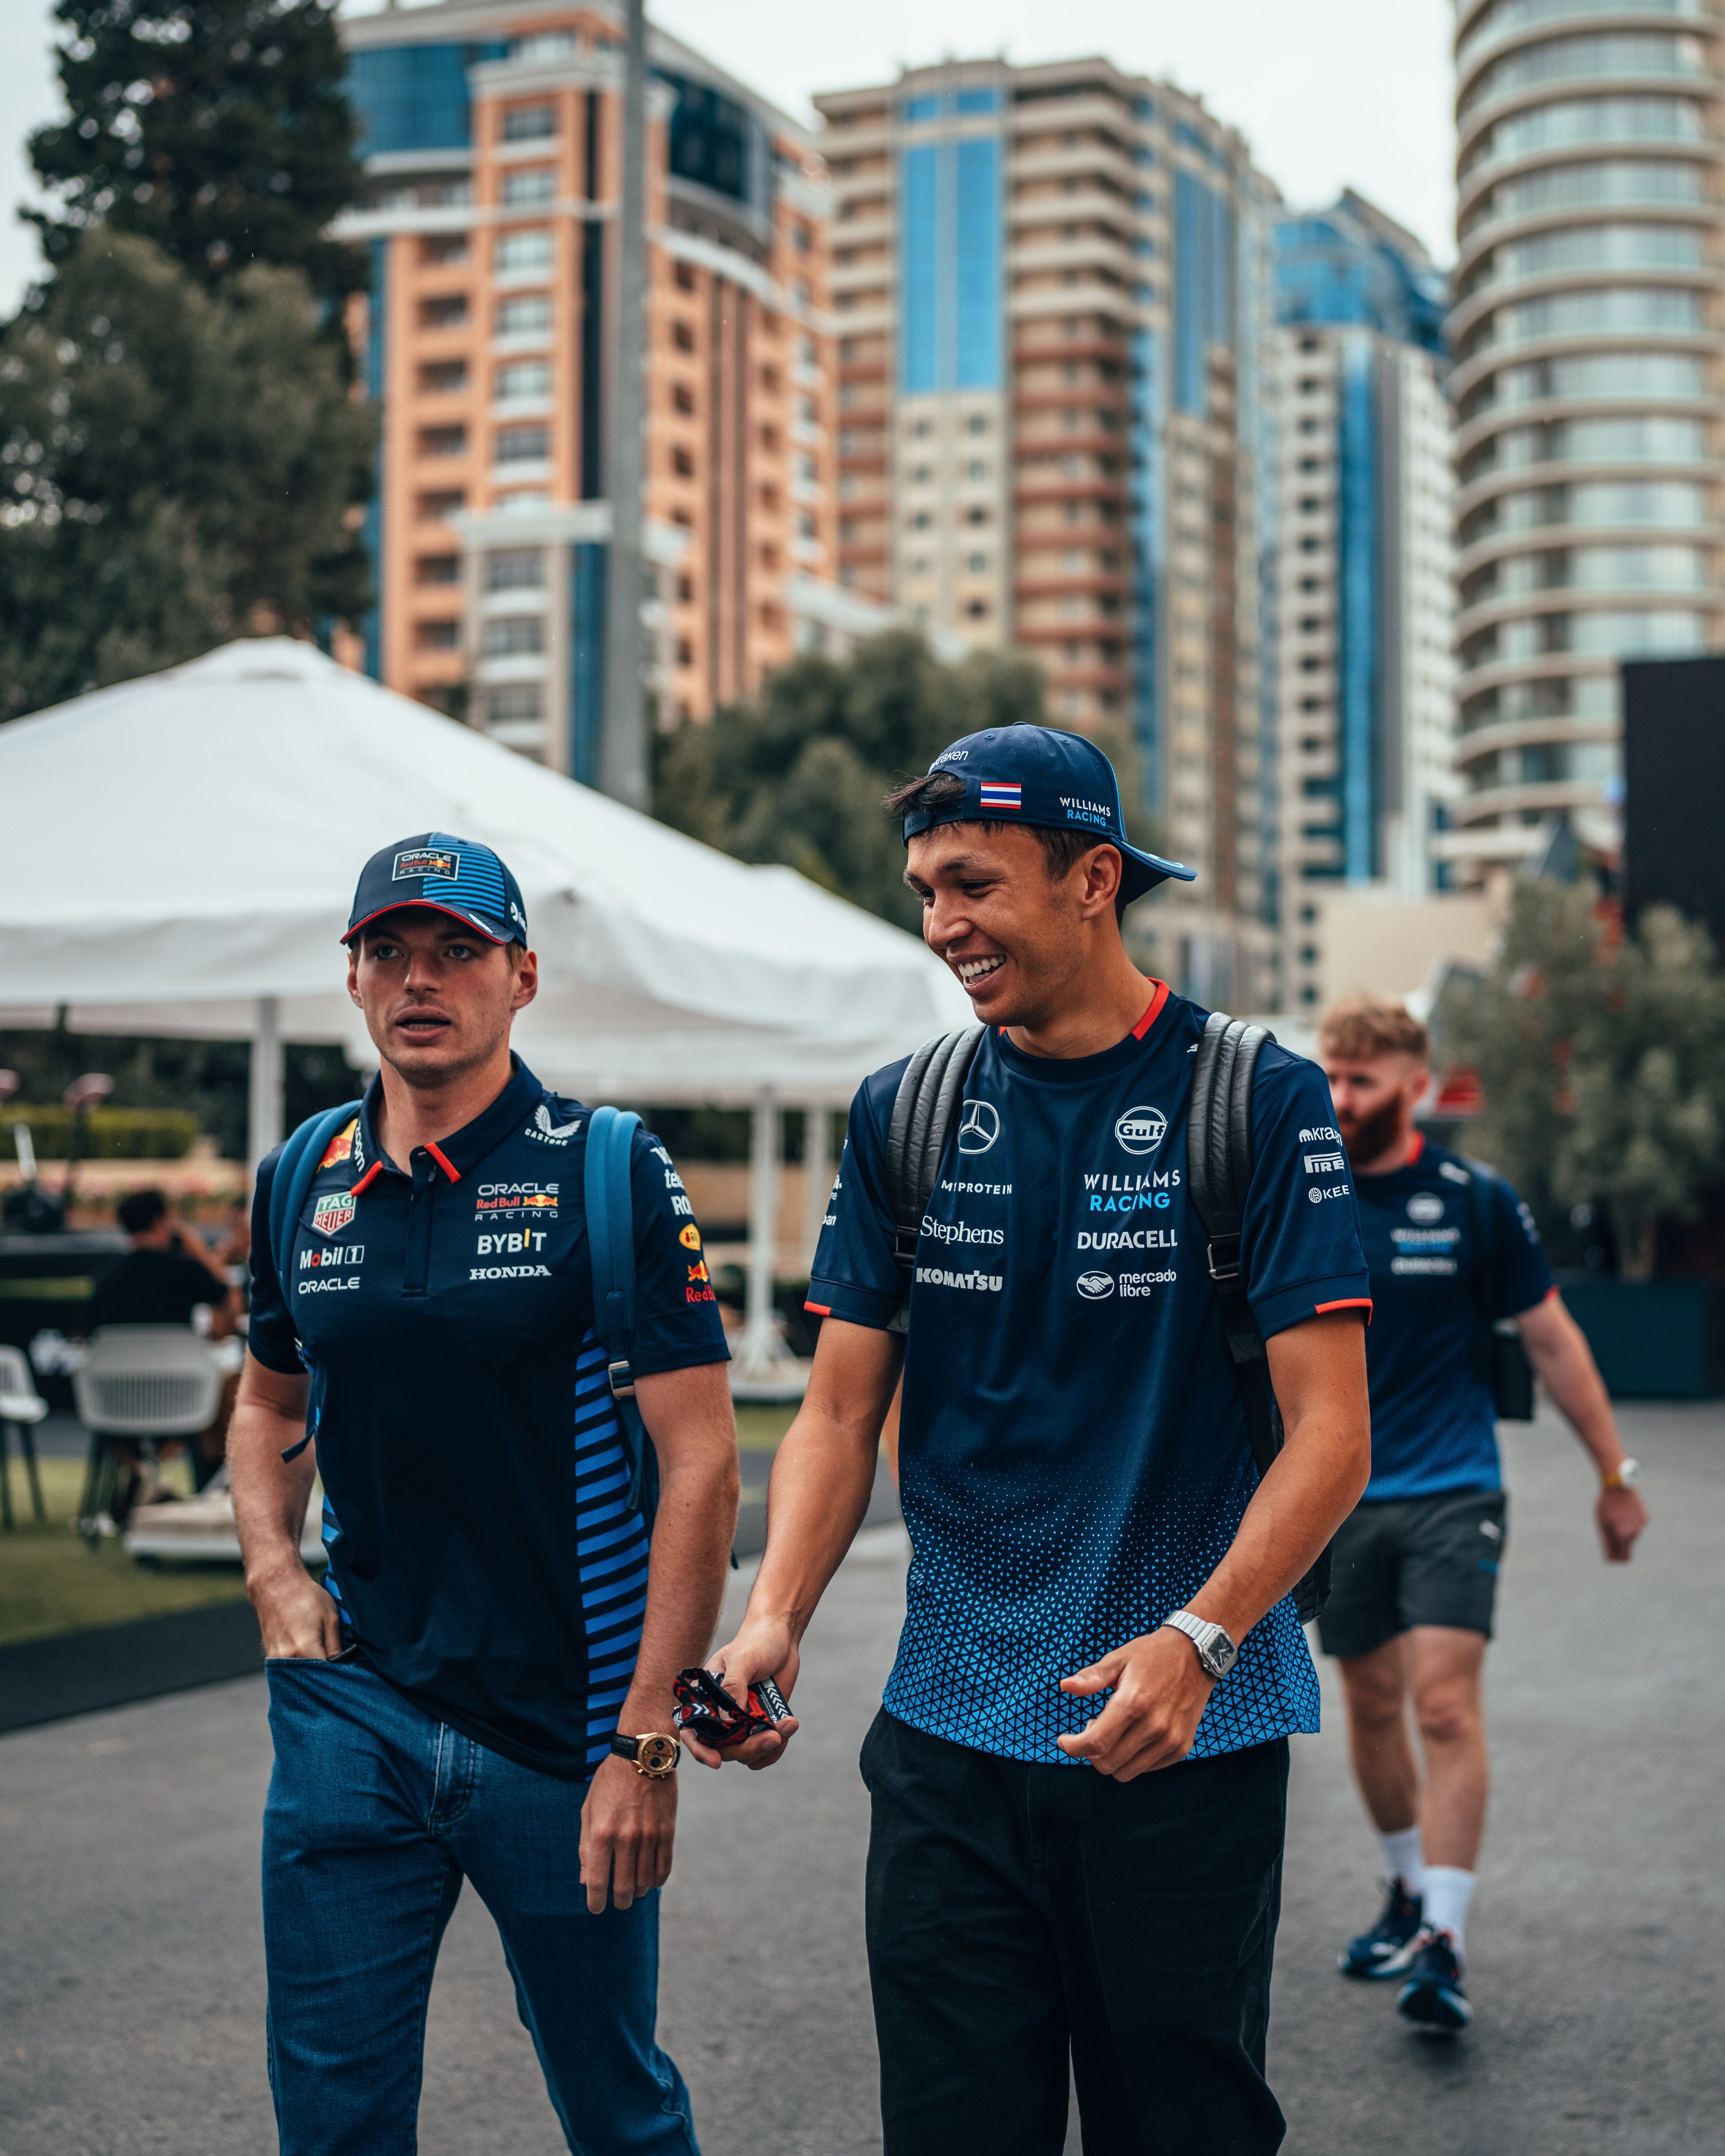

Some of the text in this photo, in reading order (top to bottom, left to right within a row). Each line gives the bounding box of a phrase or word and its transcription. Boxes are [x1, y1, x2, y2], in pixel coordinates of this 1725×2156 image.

[1059, 797, 1111, 817] WILLIAMS
[1067, 809, 1106, 826] RACING
[402, 852, 451, 862] ORACLE
[525, 1128, 568, 1146] CASTORE
[1118, 1123, 1165, 1137] Gulf
[1084, 1169, 1181, 1191] WILLIAMS
[478, 1183, 559, 1196] ORACLE
[322, 1193, 353, 1211] TAG
[476, 1196, 520, 1209] Red Bull
[1090, 1192, 1170, 1211] RACING
[315, 1209, 353, 1231] HEUER
[475, 1211, 558, 1221] RACING
[920, 1215, 1004, 1244] Stephens
[477, 1228, 547, 1255] BYBIT
[1077, 1229, 1178, 1250] DURACELL
[299, 1247, 344, 1270] Mobil
[469, 1265, 552, 1280] HONDA
[916, 1267, 1003, 1291] KOMATSU
[1119, 1269, 1176, 1284] mercado
[298, 1277, 361, 1294] ORACLE
[1120, 1284, 1151, 1297] libre
[758, 1683, 769, 1704] Championship
